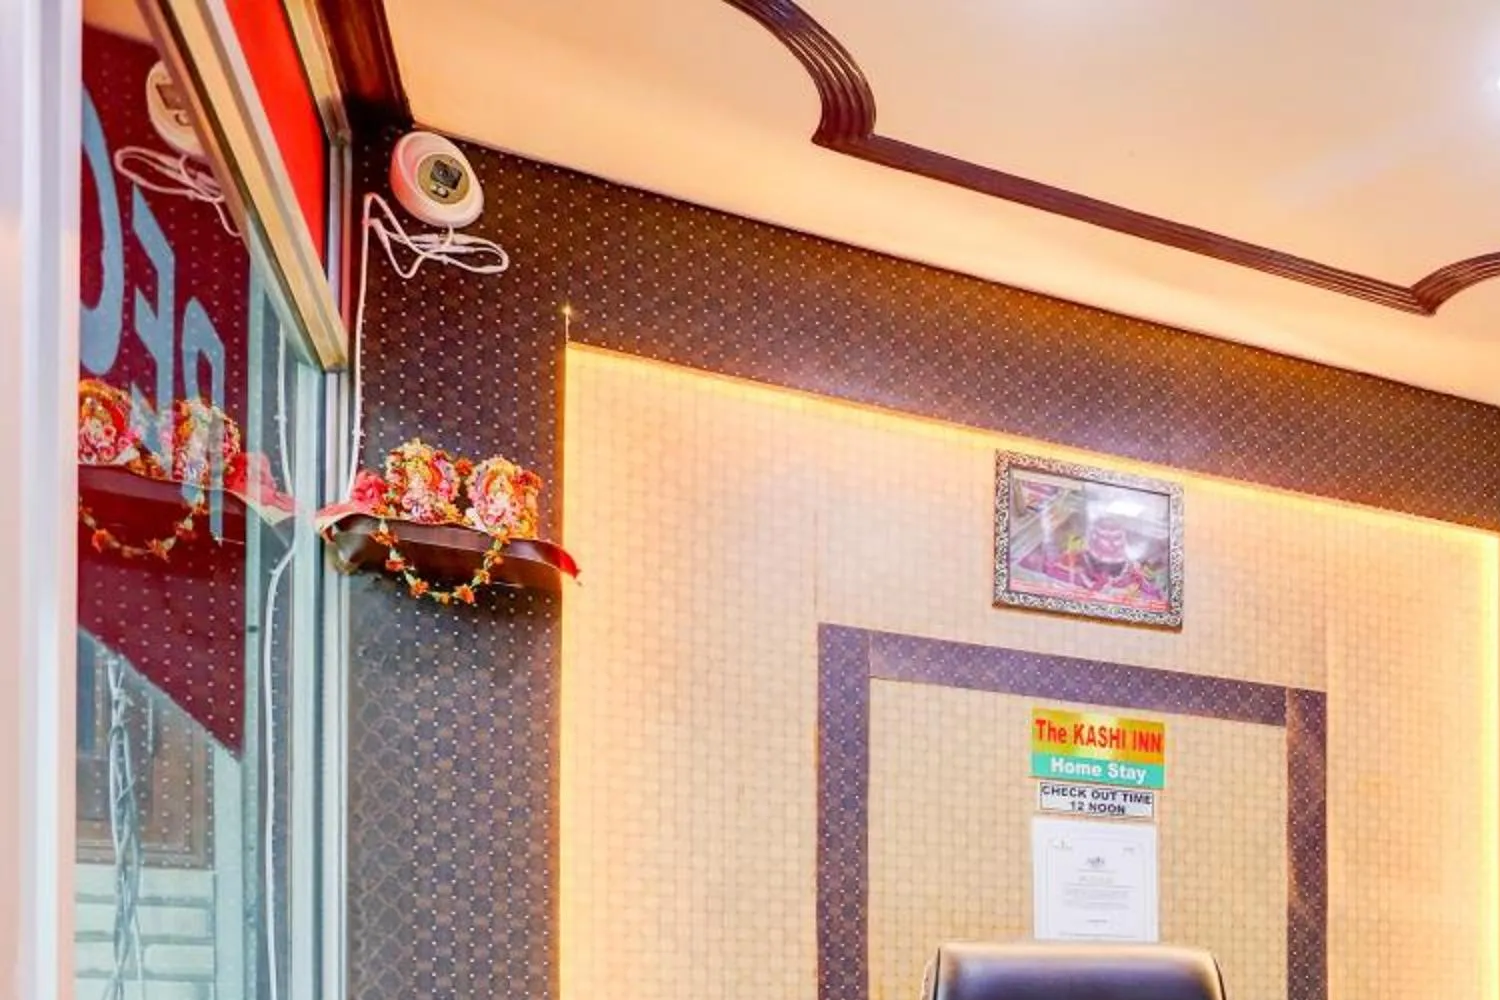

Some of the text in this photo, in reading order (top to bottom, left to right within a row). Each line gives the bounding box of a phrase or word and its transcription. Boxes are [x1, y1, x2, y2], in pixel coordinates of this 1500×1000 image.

[1035, 719, 1162, 754] The KASHI INN
[1051, 757, 1147, 785] Home Stay
[1041, 785, 1153, 805] CHECK OUT TIME
[1070, 800, 1126, 815] 12 NOON
